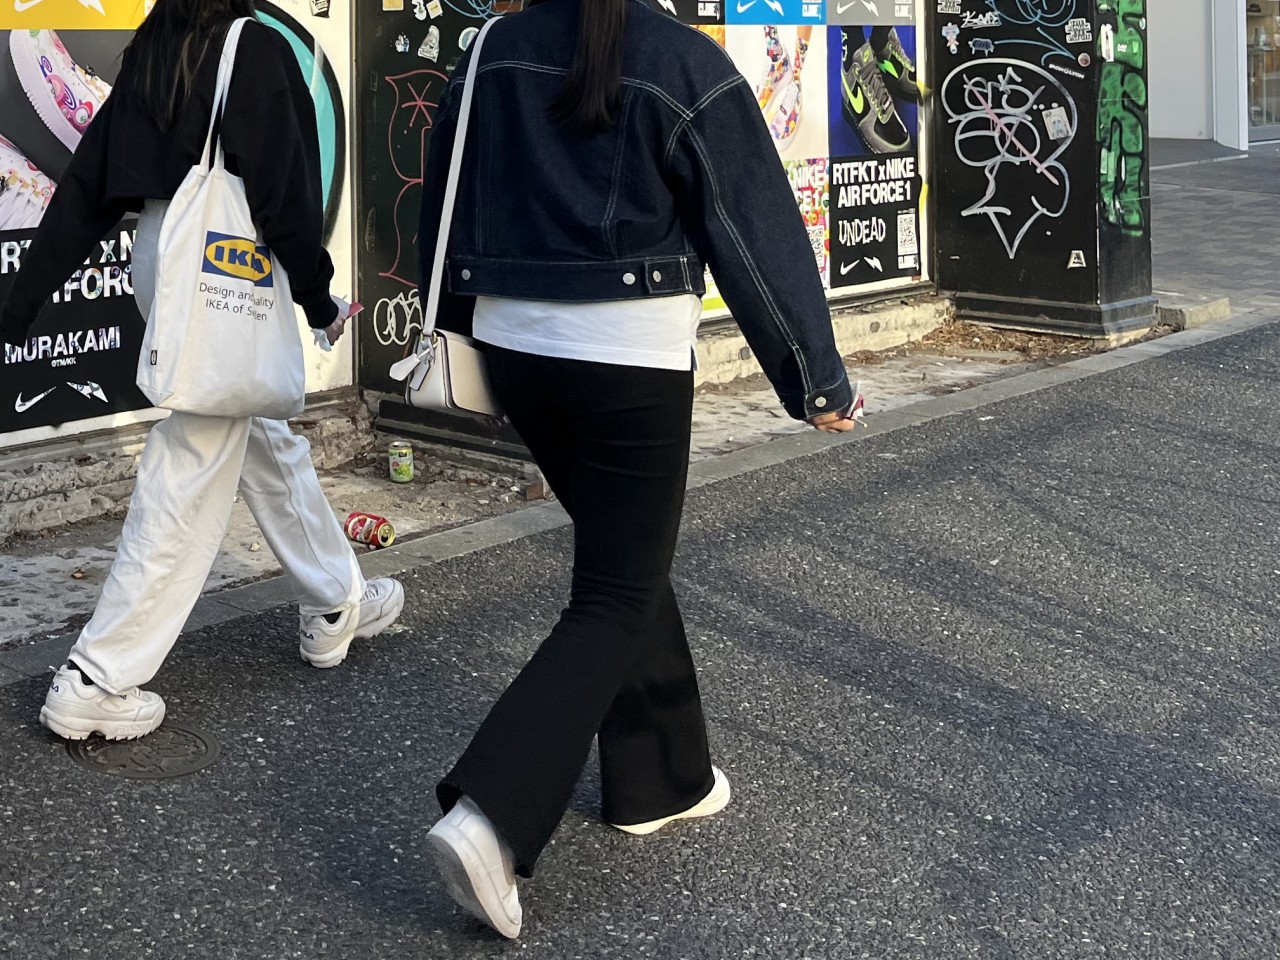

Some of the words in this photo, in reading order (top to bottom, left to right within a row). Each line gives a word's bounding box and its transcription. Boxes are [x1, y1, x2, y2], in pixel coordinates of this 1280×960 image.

[793, 164, 825, 190] NIKE
[832, 160, 878, 186] RTFKT
[878, 165, 886, 182] x
[886, 157, 915, 181] NIKE
[837, 185, 863, 209] AIR
[862, 182, 904, 207] FORCE
[904, 182, 911, 201] 1
[838, 216, 886, 247] UNDEAD
[99, 240, 117, 263] x
[199, 282, 235, 299] Design
[206, 298, 230, 312] IKEA
[233, 304, 244, 314] of
[4, 325, 121, 364] MURAKAMI
